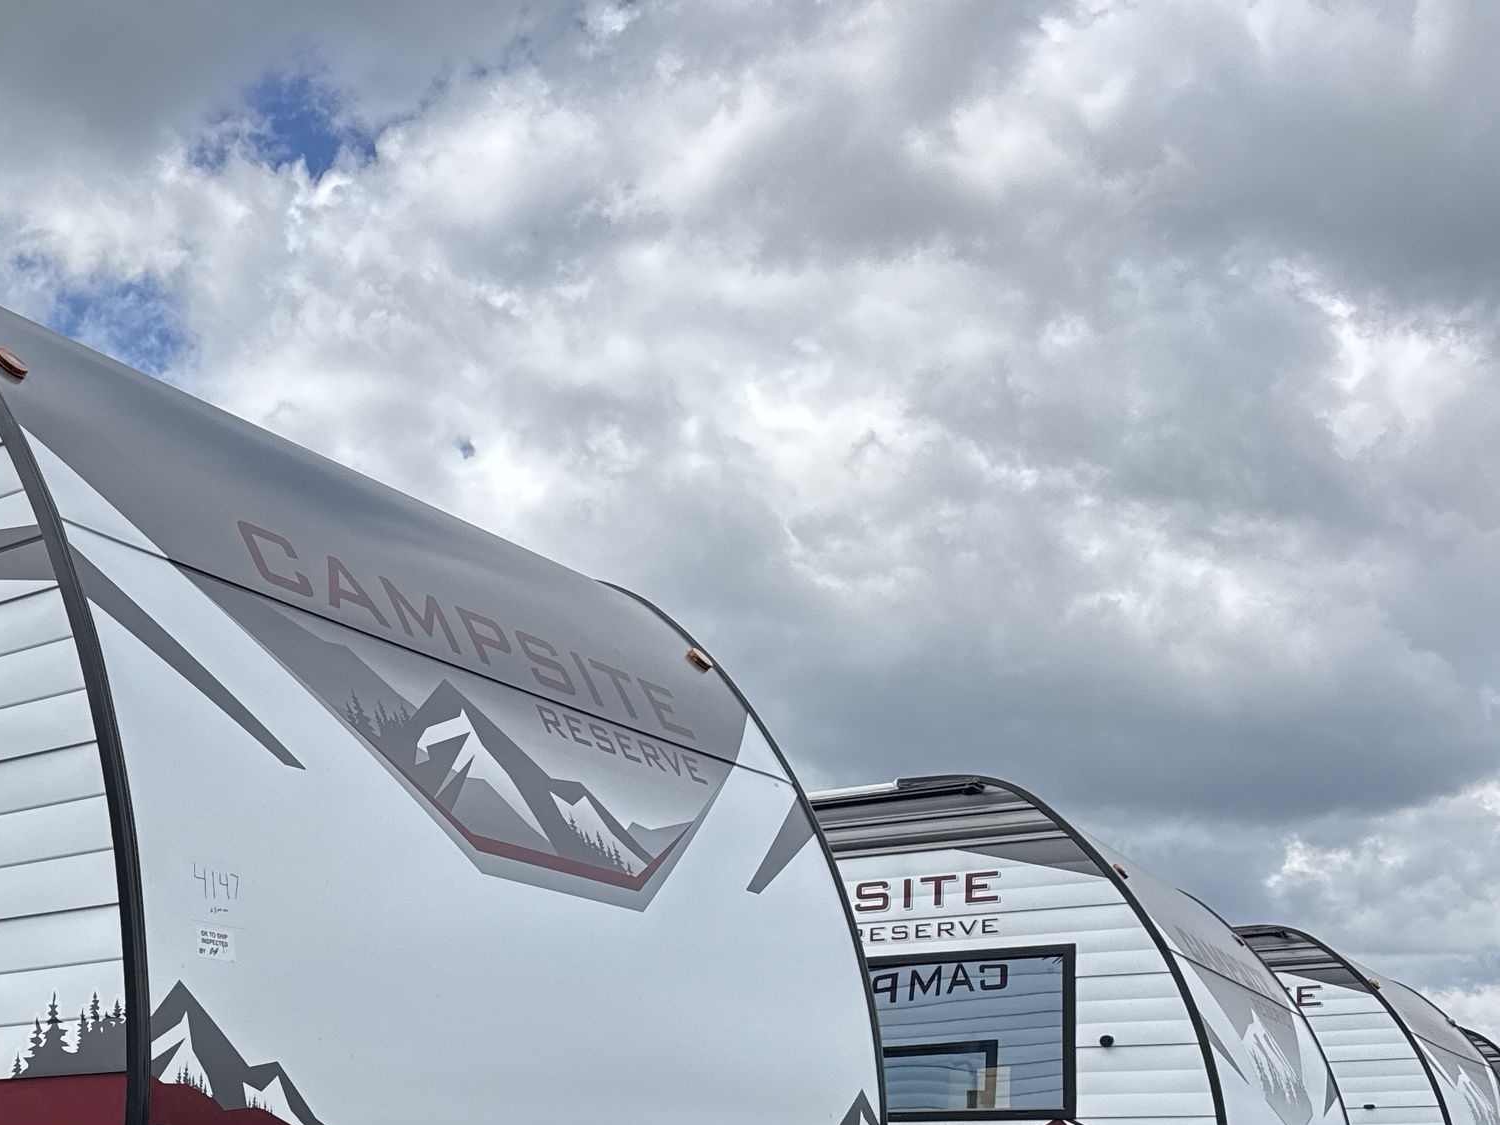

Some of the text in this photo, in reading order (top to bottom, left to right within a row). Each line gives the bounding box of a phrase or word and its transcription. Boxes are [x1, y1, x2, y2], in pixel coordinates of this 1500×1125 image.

[236, 520, 697, 741] CAMPSITE
[535, 703, 709, 786] RESERVE
[193, 862, 239, 900] 4147
